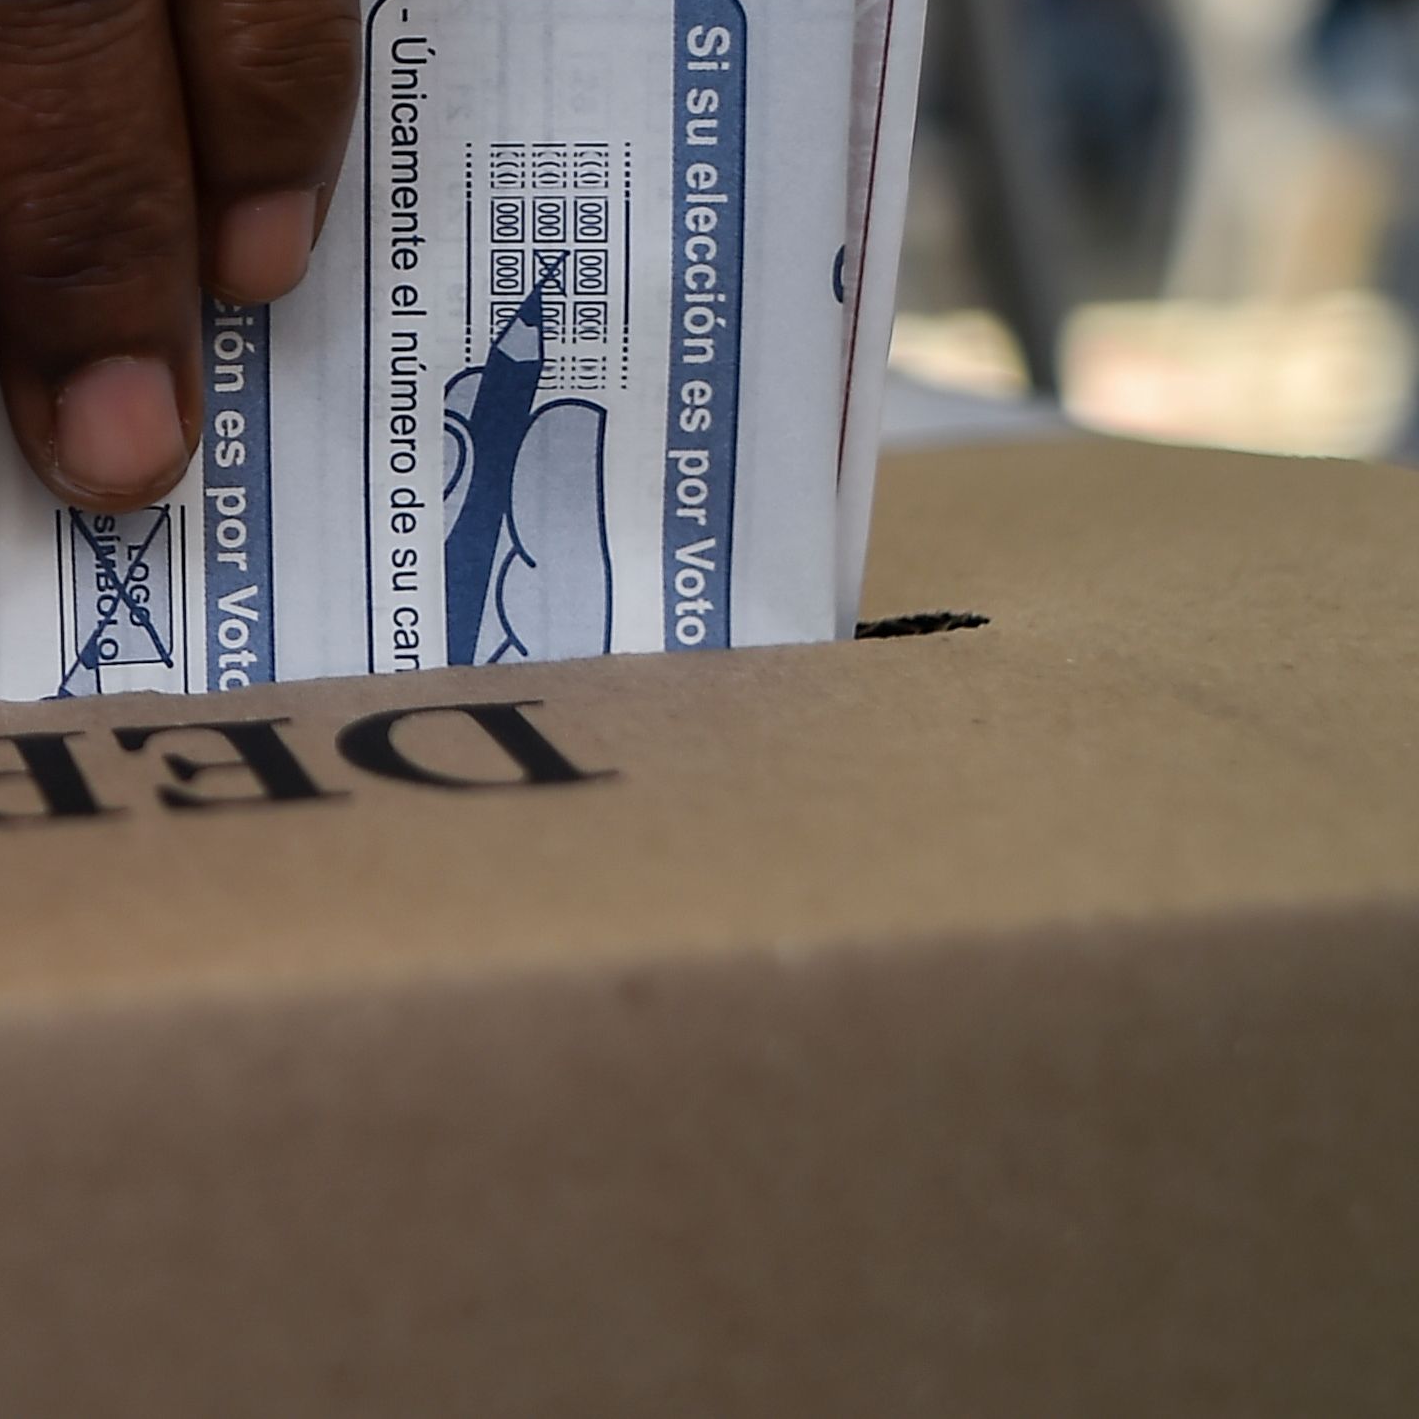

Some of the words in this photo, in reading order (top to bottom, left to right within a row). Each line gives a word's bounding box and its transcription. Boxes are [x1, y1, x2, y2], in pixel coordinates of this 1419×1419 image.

[686, 25, 730, 71] Si
[391, 37, 435, 270] Únicamente
[686, 88, 721, 146] su
[683, 163, 727, 363] elección
[391, 285, 426, 316] el
[215, 410, 246, 468] es
[391, 332, 426, 474] número
[680, 381, 715, 432] es
[391, 489, 424, 533] de
[669, 450, 714, 524] por
[205, 486, 248, 571] por
[92, 515, 123, 661] SÍMBOLO
[126, 543, 151, 628] LOGO
[393, 549, 418, 591] su
[676, 540, 716, 645] Voto
